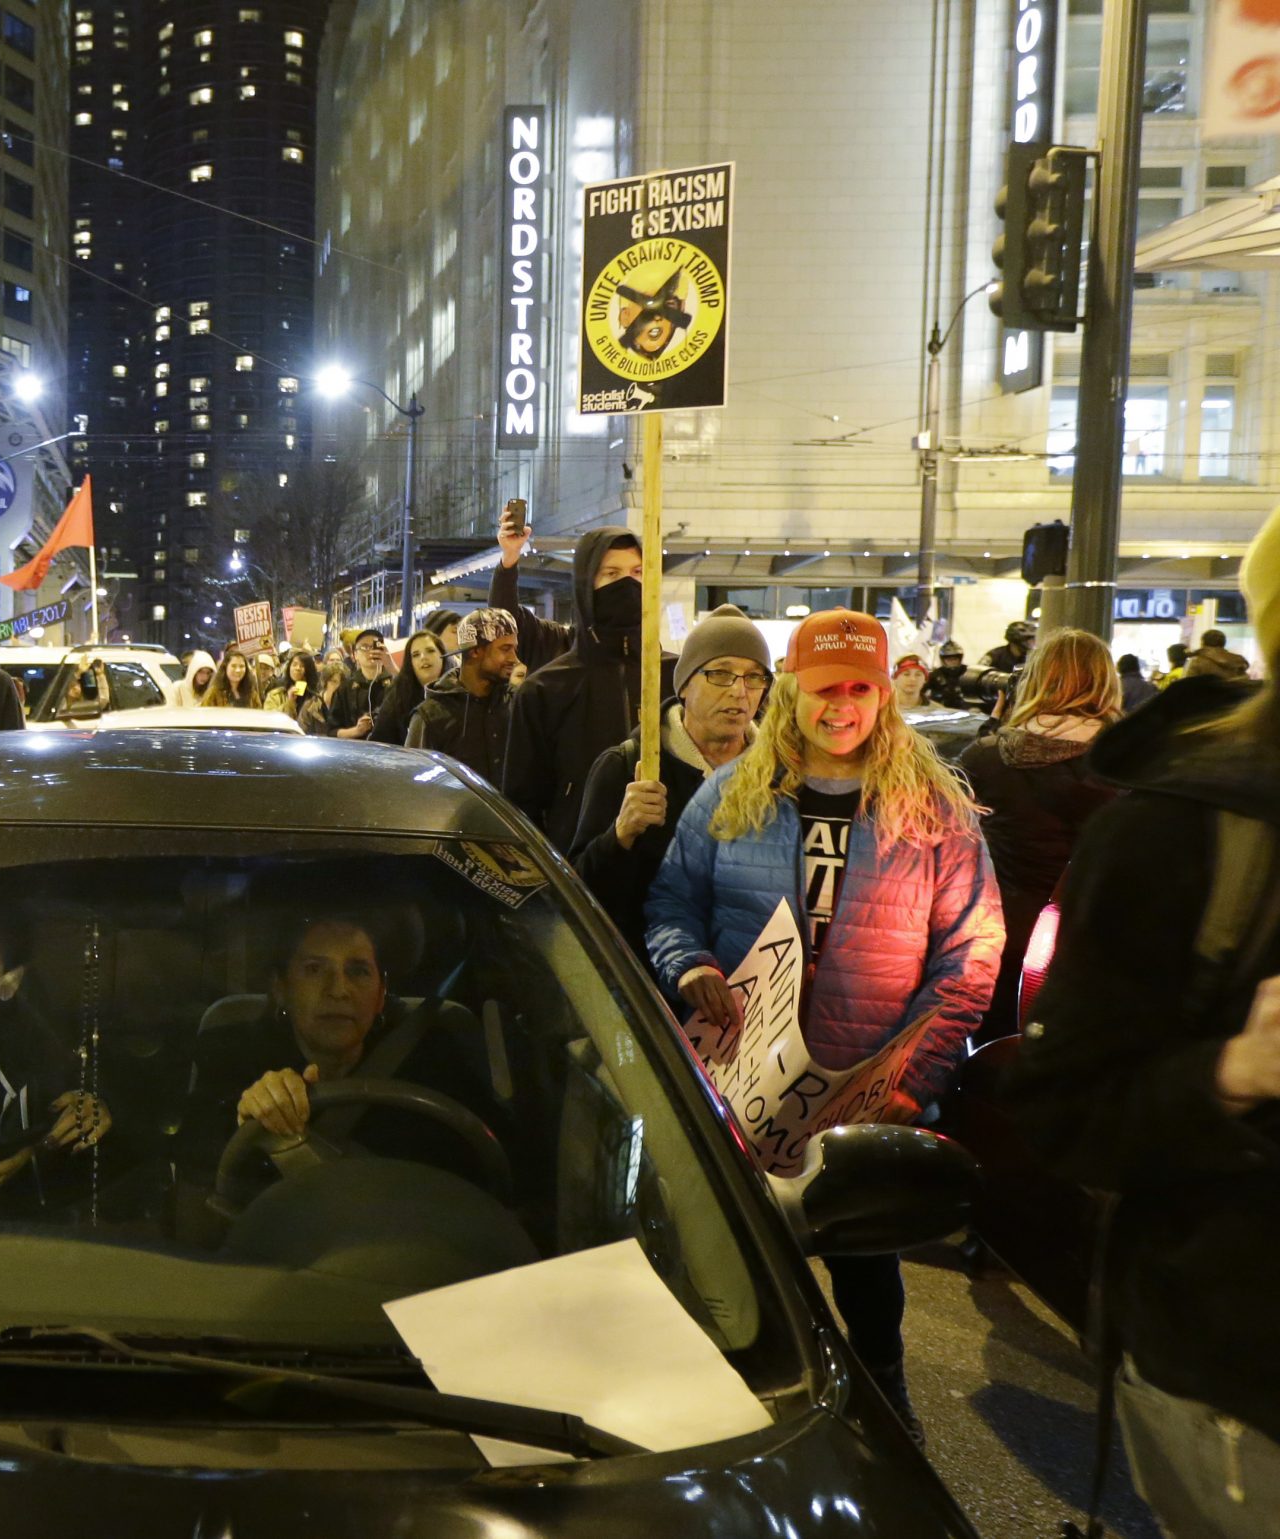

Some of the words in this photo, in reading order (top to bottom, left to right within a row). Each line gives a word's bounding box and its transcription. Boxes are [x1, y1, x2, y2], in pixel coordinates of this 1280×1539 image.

[589, 185, 644, 217] FIGHT
[648, 171, 726, 208] RACISM
[631, 213, 644, 239] &
[647, 200, 724, 236] SEXISM
[505, 117, 540, 435] NORDSTROM
[590, 272, 620, 322] UNITE
[617, 241, 687, 275] AGAINST
[683, 252, 720, 309] TRUMP
[601, 340, 618, 363] THE
[618, 355, 680, 376] BILLIONAIRE
[682, 330, 709, 363] CLASS
[582, 390, 625, 403] socialist
[582, 399, 627, 413] students
[237, 604, 268, 625] RESIST
[239, 620, 270, 641] TRUMP
[814, 633, 839, 643] MAKE
[813, 641, 847, 652] AFRAID
[853, 642, 877, 653] AGAIN
